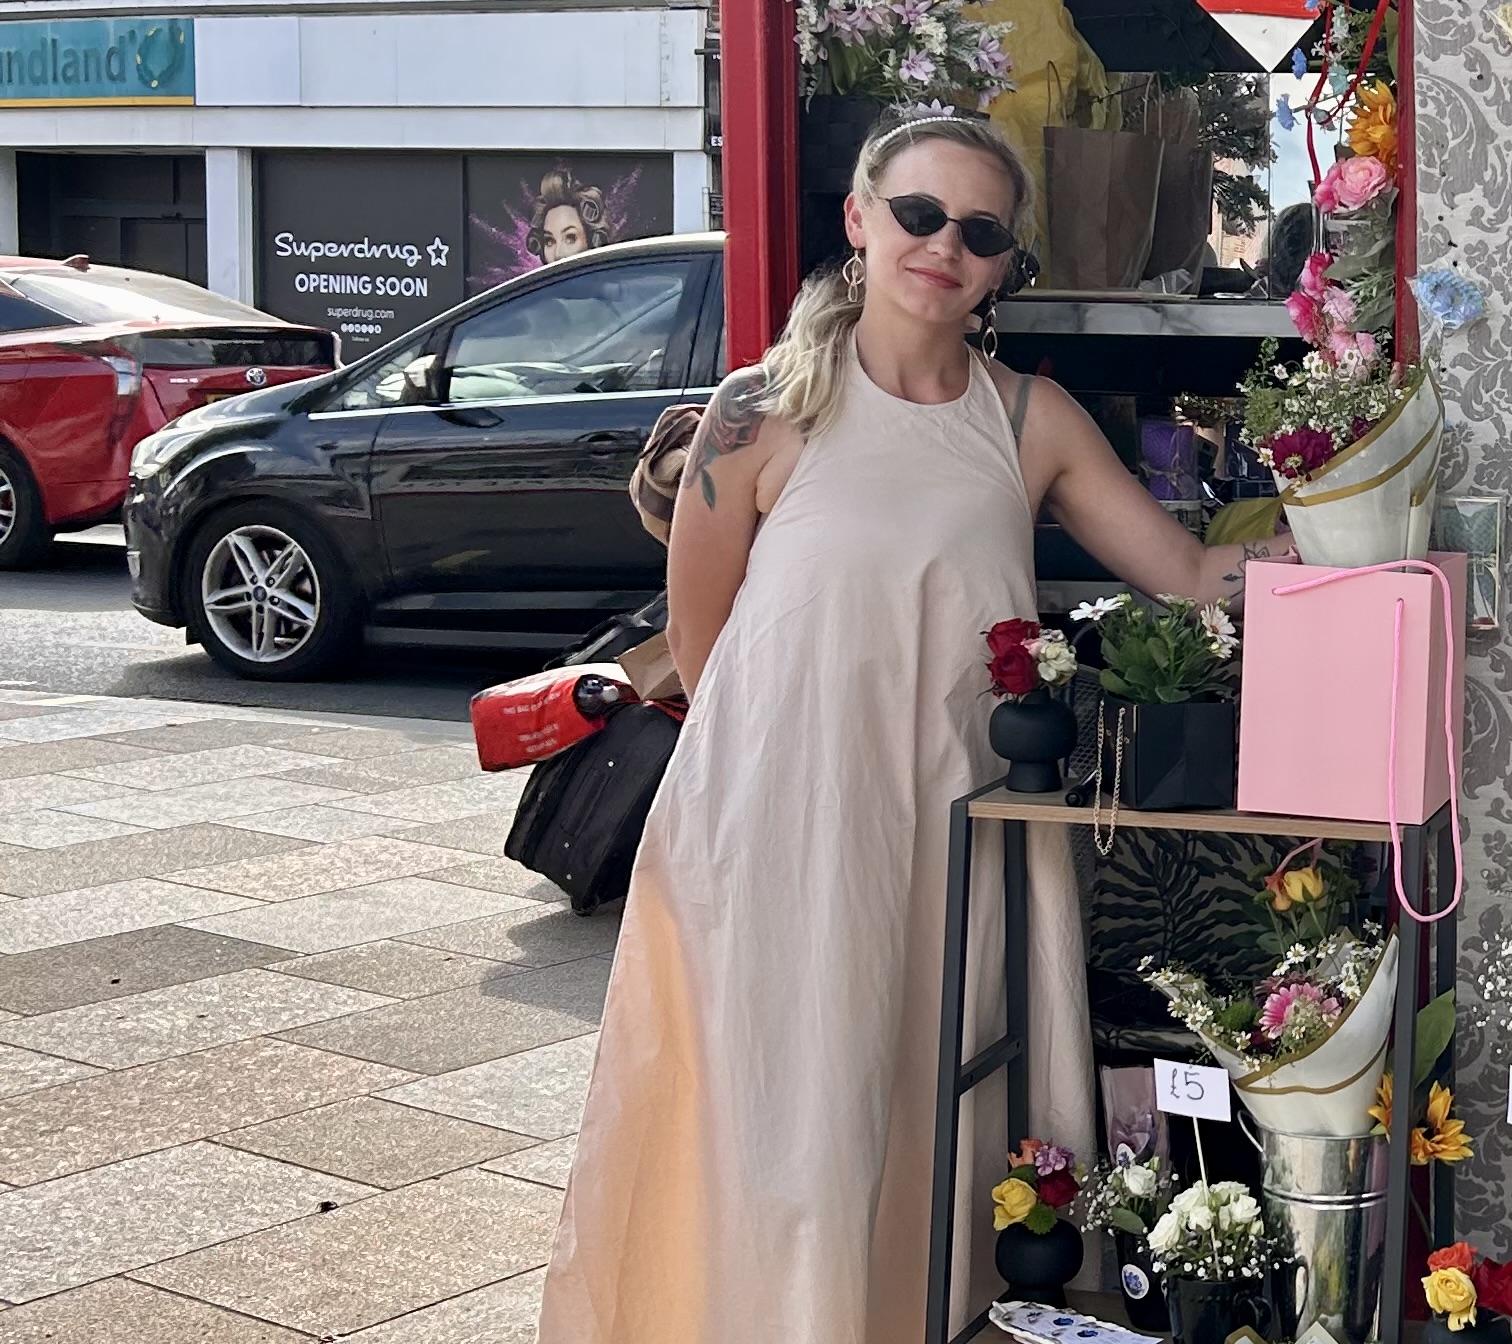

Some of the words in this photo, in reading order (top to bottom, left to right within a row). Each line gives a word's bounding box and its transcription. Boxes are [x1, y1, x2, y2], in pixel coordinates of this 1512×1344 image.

[0, 35, 126, 85] ndland
[274, 232, 422, 267] Superdrug
[295, 273, 372, 295] OPENING
[375, 276, 428, 297] SOON
[327, 306, 395, 320] superdrug.com
[1170, 1068, 1205, 1100] £5
